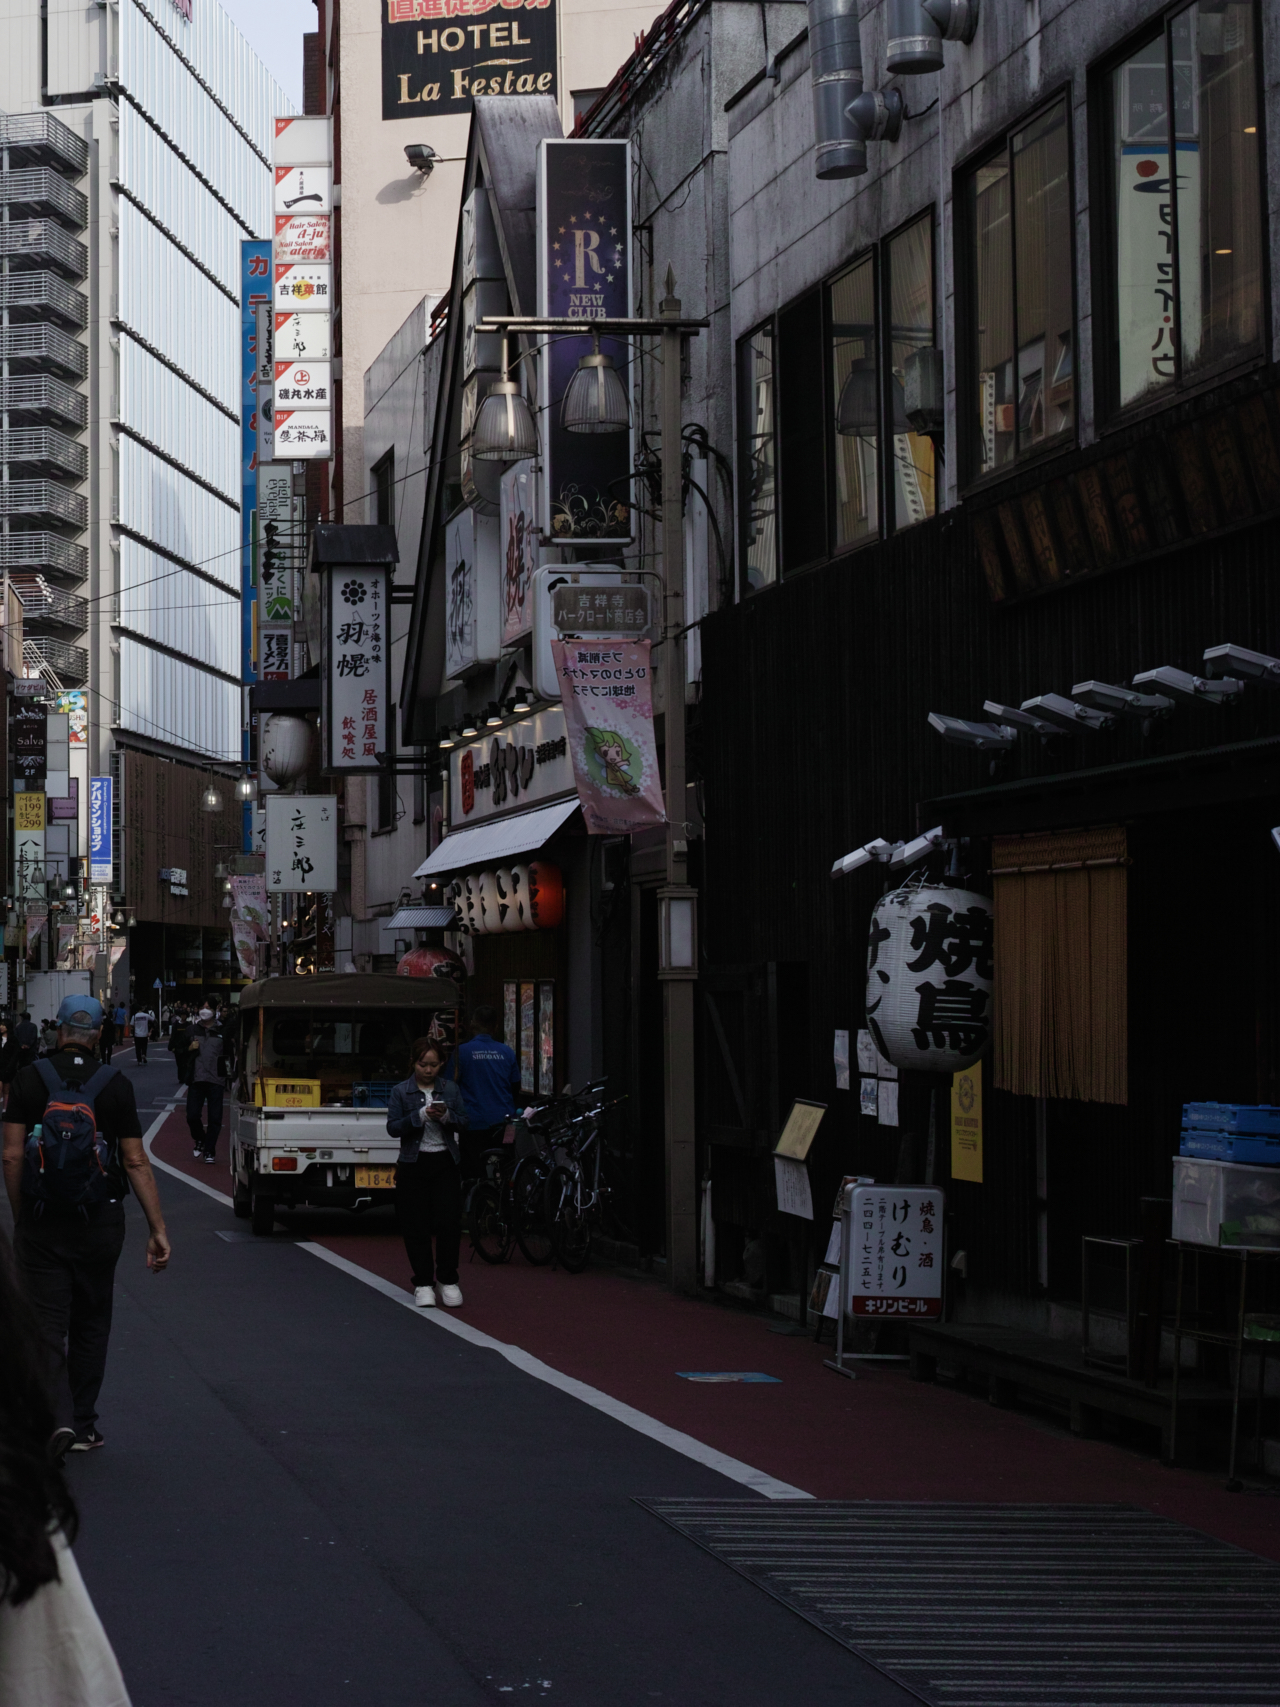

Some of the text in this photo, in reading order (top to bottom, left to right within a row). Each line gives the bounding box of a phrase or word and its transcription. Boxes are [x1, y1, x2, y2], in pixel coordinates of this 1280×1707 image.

[416, 21, 531, 54] HOTEL
[397, 61, 553, 104] La Festae
[297, 229, 324, 240] A-ju
[571, 229, 606, 289] R
[278, 283, 328, 296] 吉祥菜館
[569, 294, 604, 307] NEW
[567, 306, 607, 319] CLUB
[278, 388, 327, 400] 磯丸水産
[266, 479, 281, 520] eyelash
[278, 479, 291, 507] eight
[557, 609, 645, 624] パークロード商店会
[577, 594, 625, 607] 吉祥寺
[371, 578, 382, 663] オホーツク海の味
[263, 634, 275, 670] ラーメン
[276, 634, 288, 670] 喜多方
[342, 716, 356, 760] 飲喰処
[361, 689, 377, 756] 居酒屋風
[91, 782, 102, 851] アパマンショップ
[906, 902, 993, 1056] 焼鳥
[891, 1199, 911, 1290] けむり
[865, 1299, 928, 1313] キリンビール
